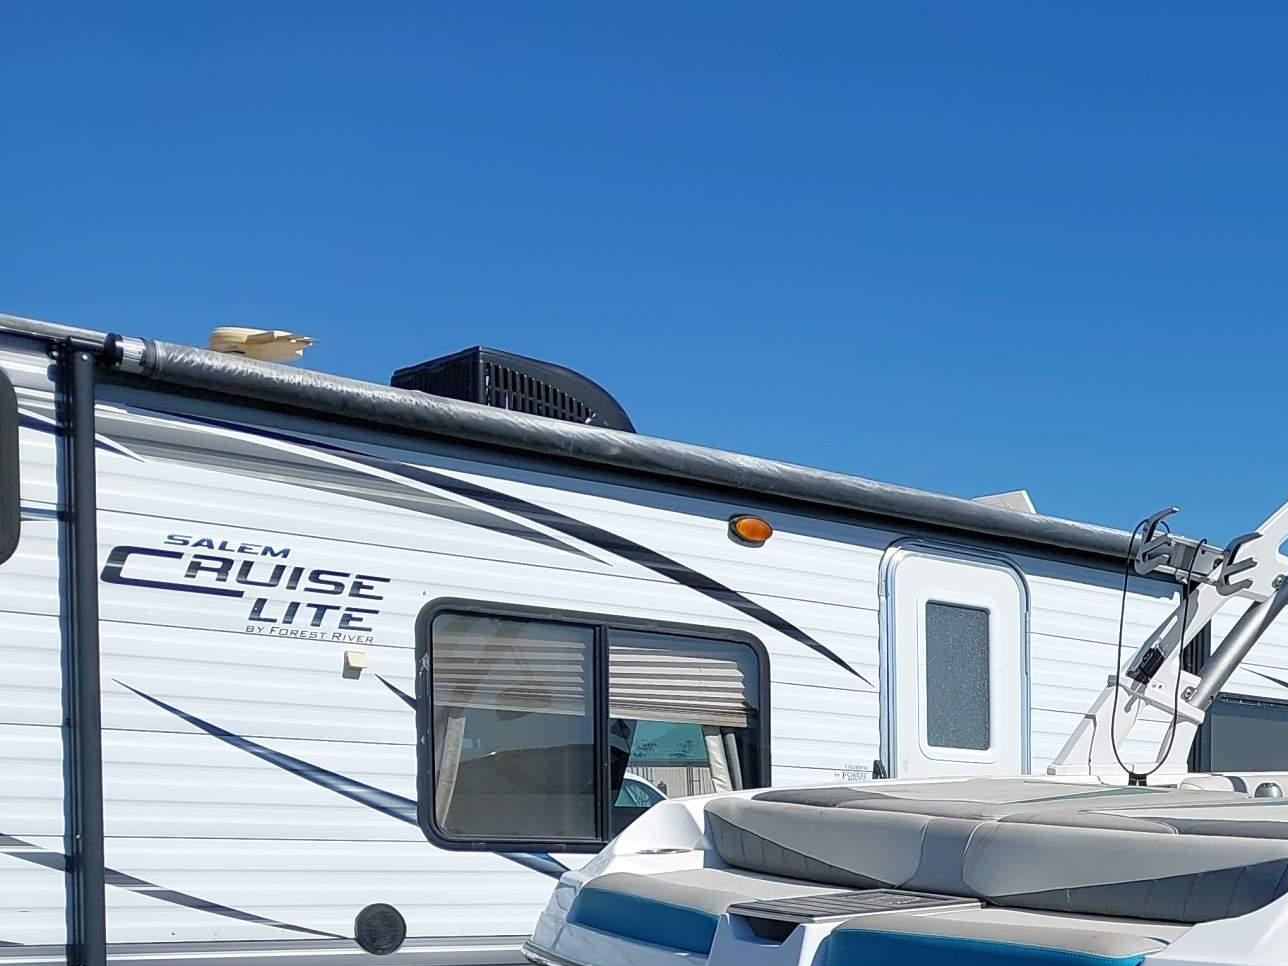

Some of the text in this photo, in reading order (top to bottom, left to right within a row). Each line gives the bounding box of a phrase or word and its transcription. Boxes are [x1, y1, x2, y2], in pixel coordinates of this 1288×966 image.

[164, 533, 291, 559] SALEM
[100, 545, 392, 601] CRUISE
[248, 597, 380, 632] LITE
[245, 625, 375, 644] BY FOREST RIVER
